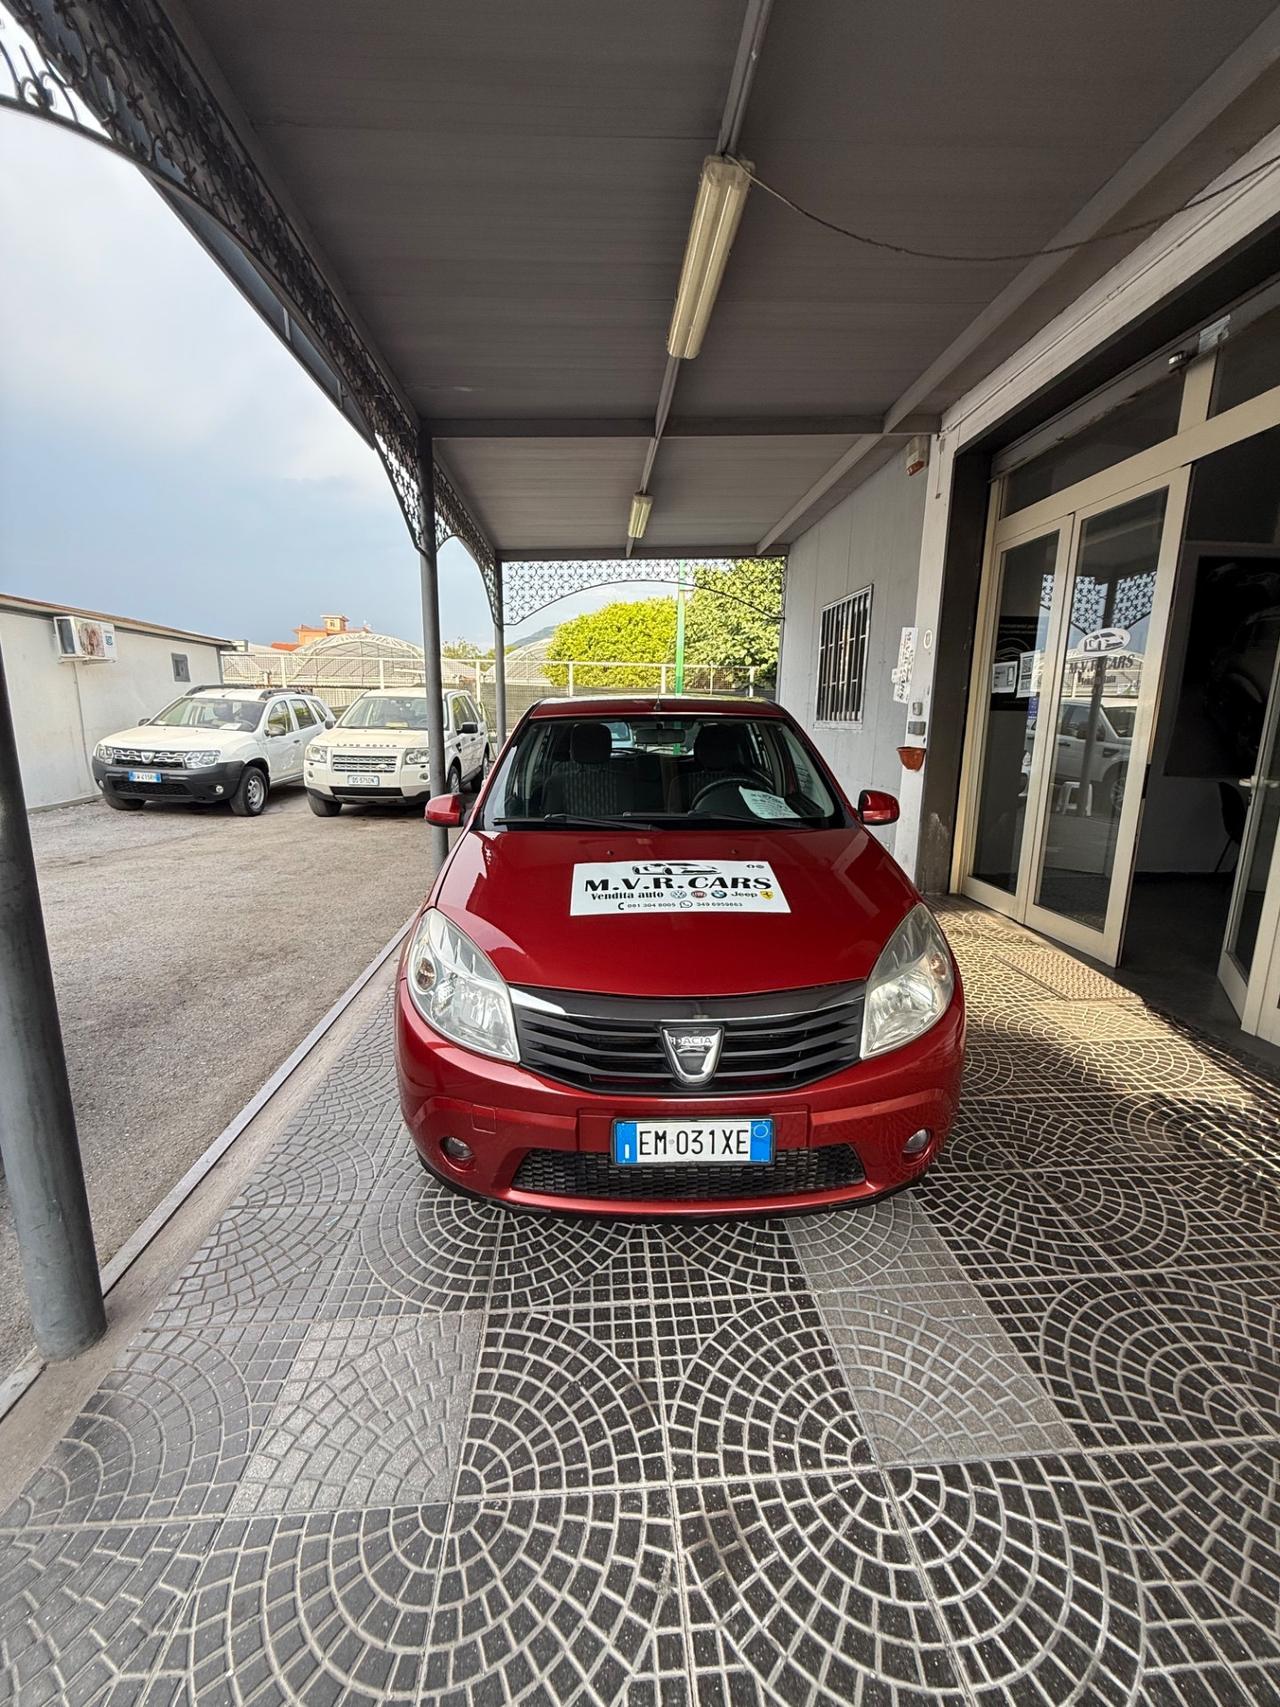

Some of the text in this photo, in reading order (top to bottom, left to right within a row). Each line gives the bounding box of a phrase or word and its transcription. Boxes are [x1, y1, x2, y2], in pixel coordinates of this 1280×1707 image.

[584, 876, 773, 892] M.V.R.CARS
[591, 890, 758, 900] Vendita auto Jeep
